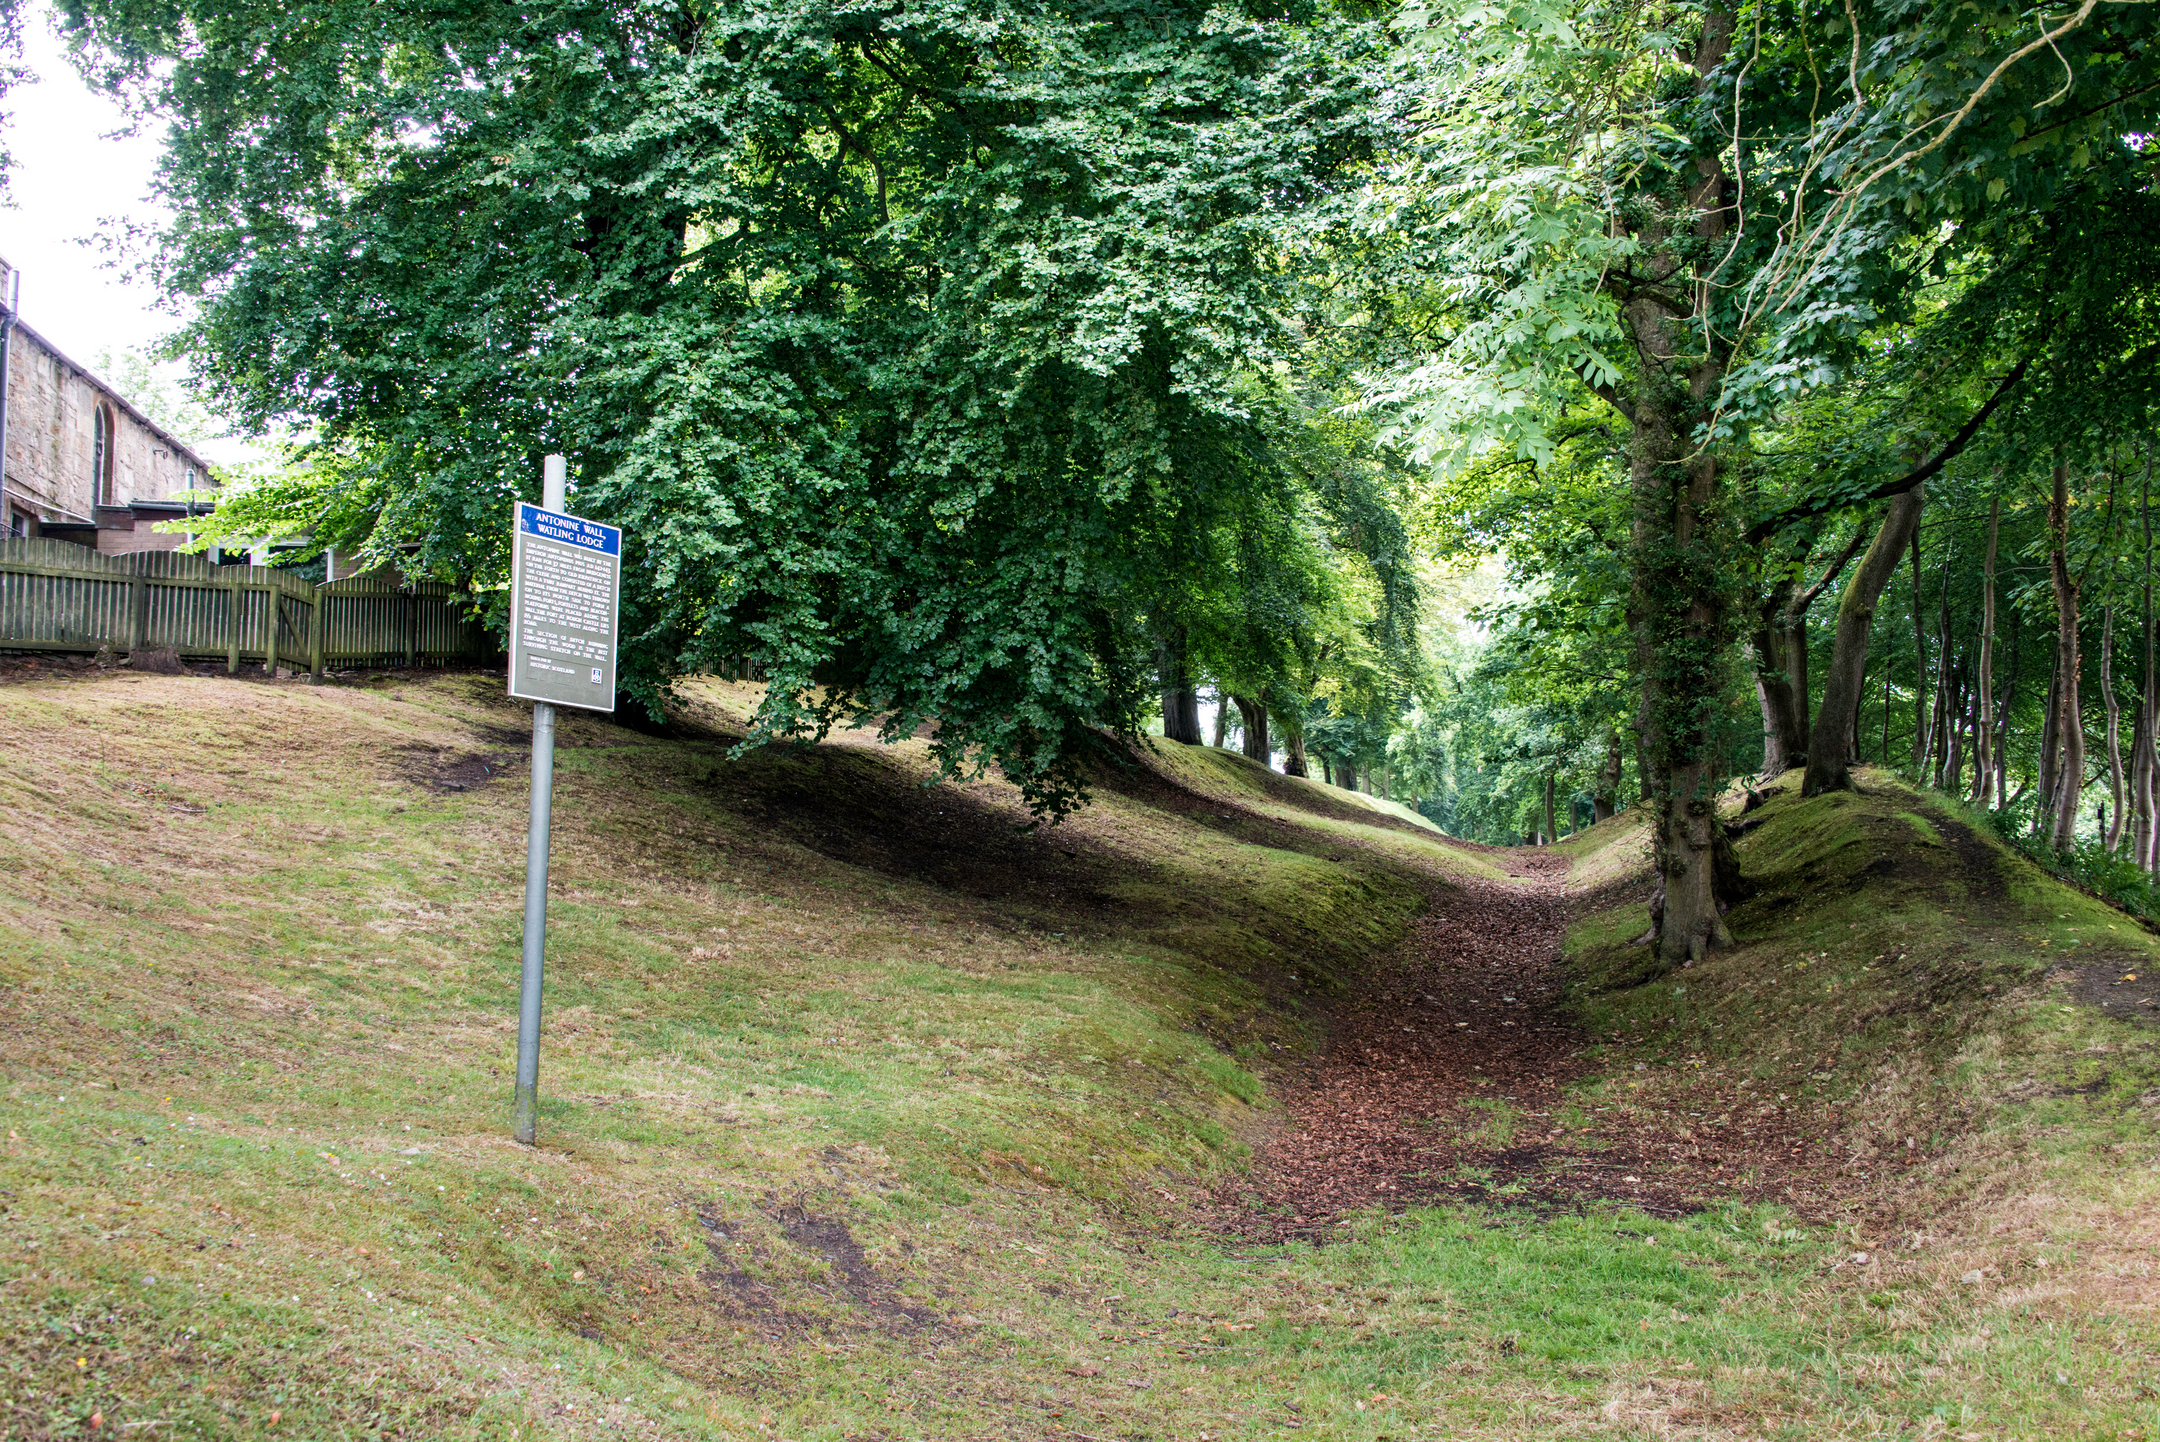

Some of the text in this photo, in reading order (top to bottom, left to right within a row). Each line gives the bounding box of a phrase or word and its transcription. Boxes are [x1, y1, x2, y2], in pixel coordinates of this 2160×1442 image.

[536, 512, 606, 540] ANTONINE WALL,
[537, 523, 603, 548] WATLING LODGE
[530, 661, 575, 674] HISTORIC SCOTLAND
